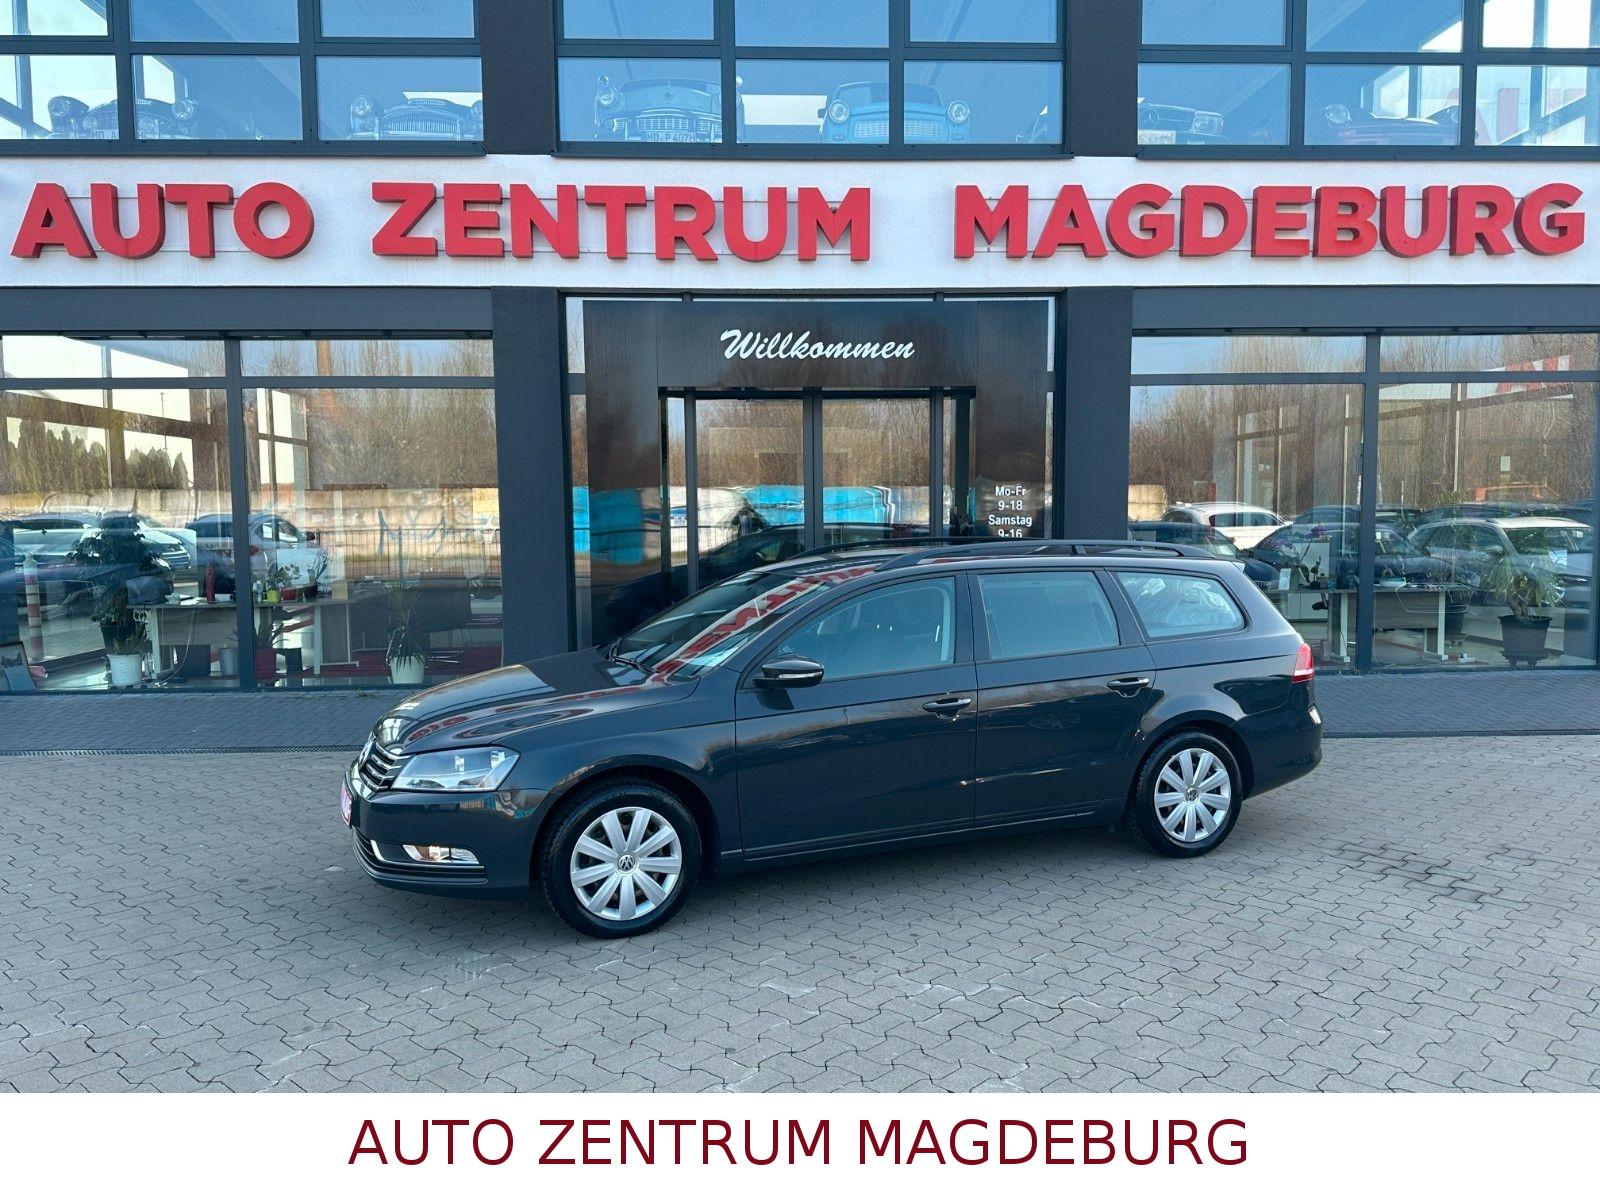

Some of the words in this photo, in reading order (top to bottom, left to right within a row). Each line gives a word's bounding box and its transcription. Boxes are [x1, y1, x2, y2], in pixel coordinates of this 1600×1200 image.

[12, 182, 313, 258] AUTO
[371, 182, 871, 261] ZENTRUM
[954, 182, 1586, 258] MAGDEBURG
[720, 328, 916, 360] Willkommen
[995, 485, 1027, 497] Mo-Fr
[998, 500, 1023, 511] 9-18
[988, 514, 1033, 527] Samstag
[997, 528, 1023, 538] 9-16
